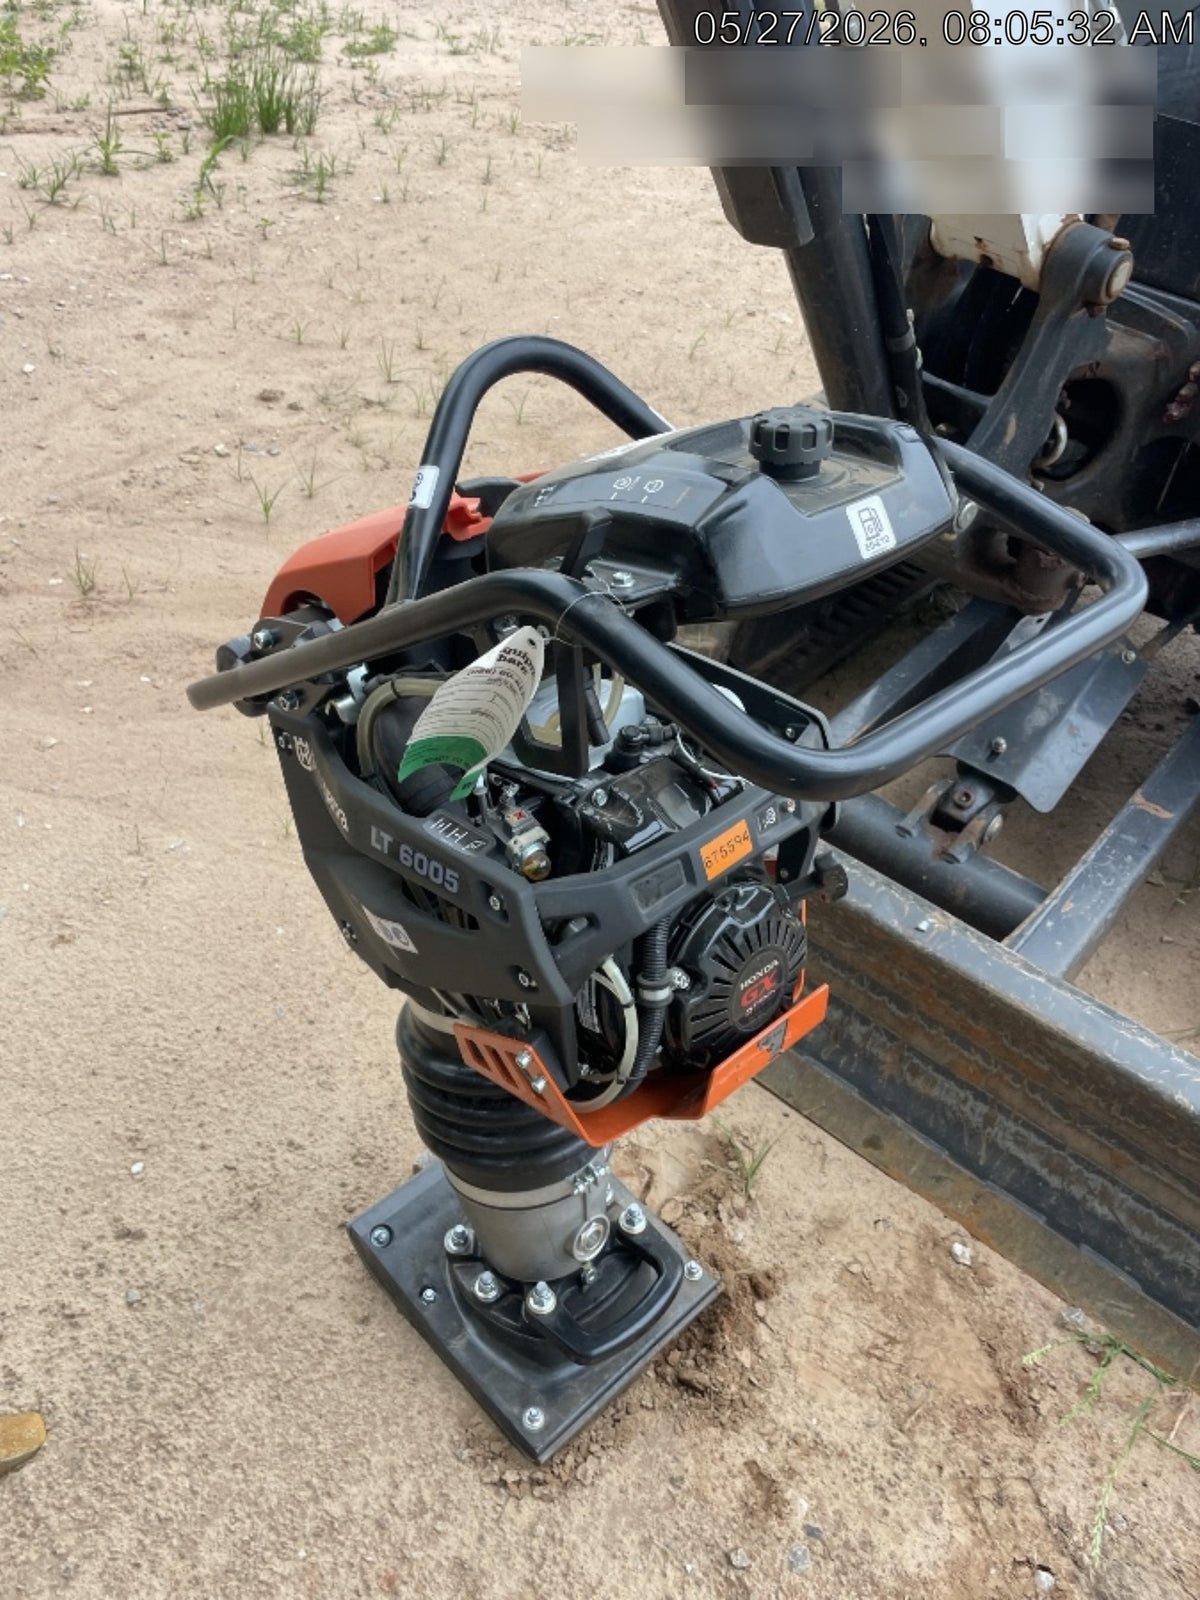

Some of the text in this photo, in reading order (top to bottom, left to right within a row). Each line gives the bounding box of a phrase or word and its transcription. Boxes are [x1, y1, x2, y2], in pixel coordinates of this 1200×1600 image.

[370, 825, 460, 894] LT 6005
[704, 829, 751, 869] 675594
[740, 959, 780, 990] HONDA
[741, 970, 778, 1007] GX
